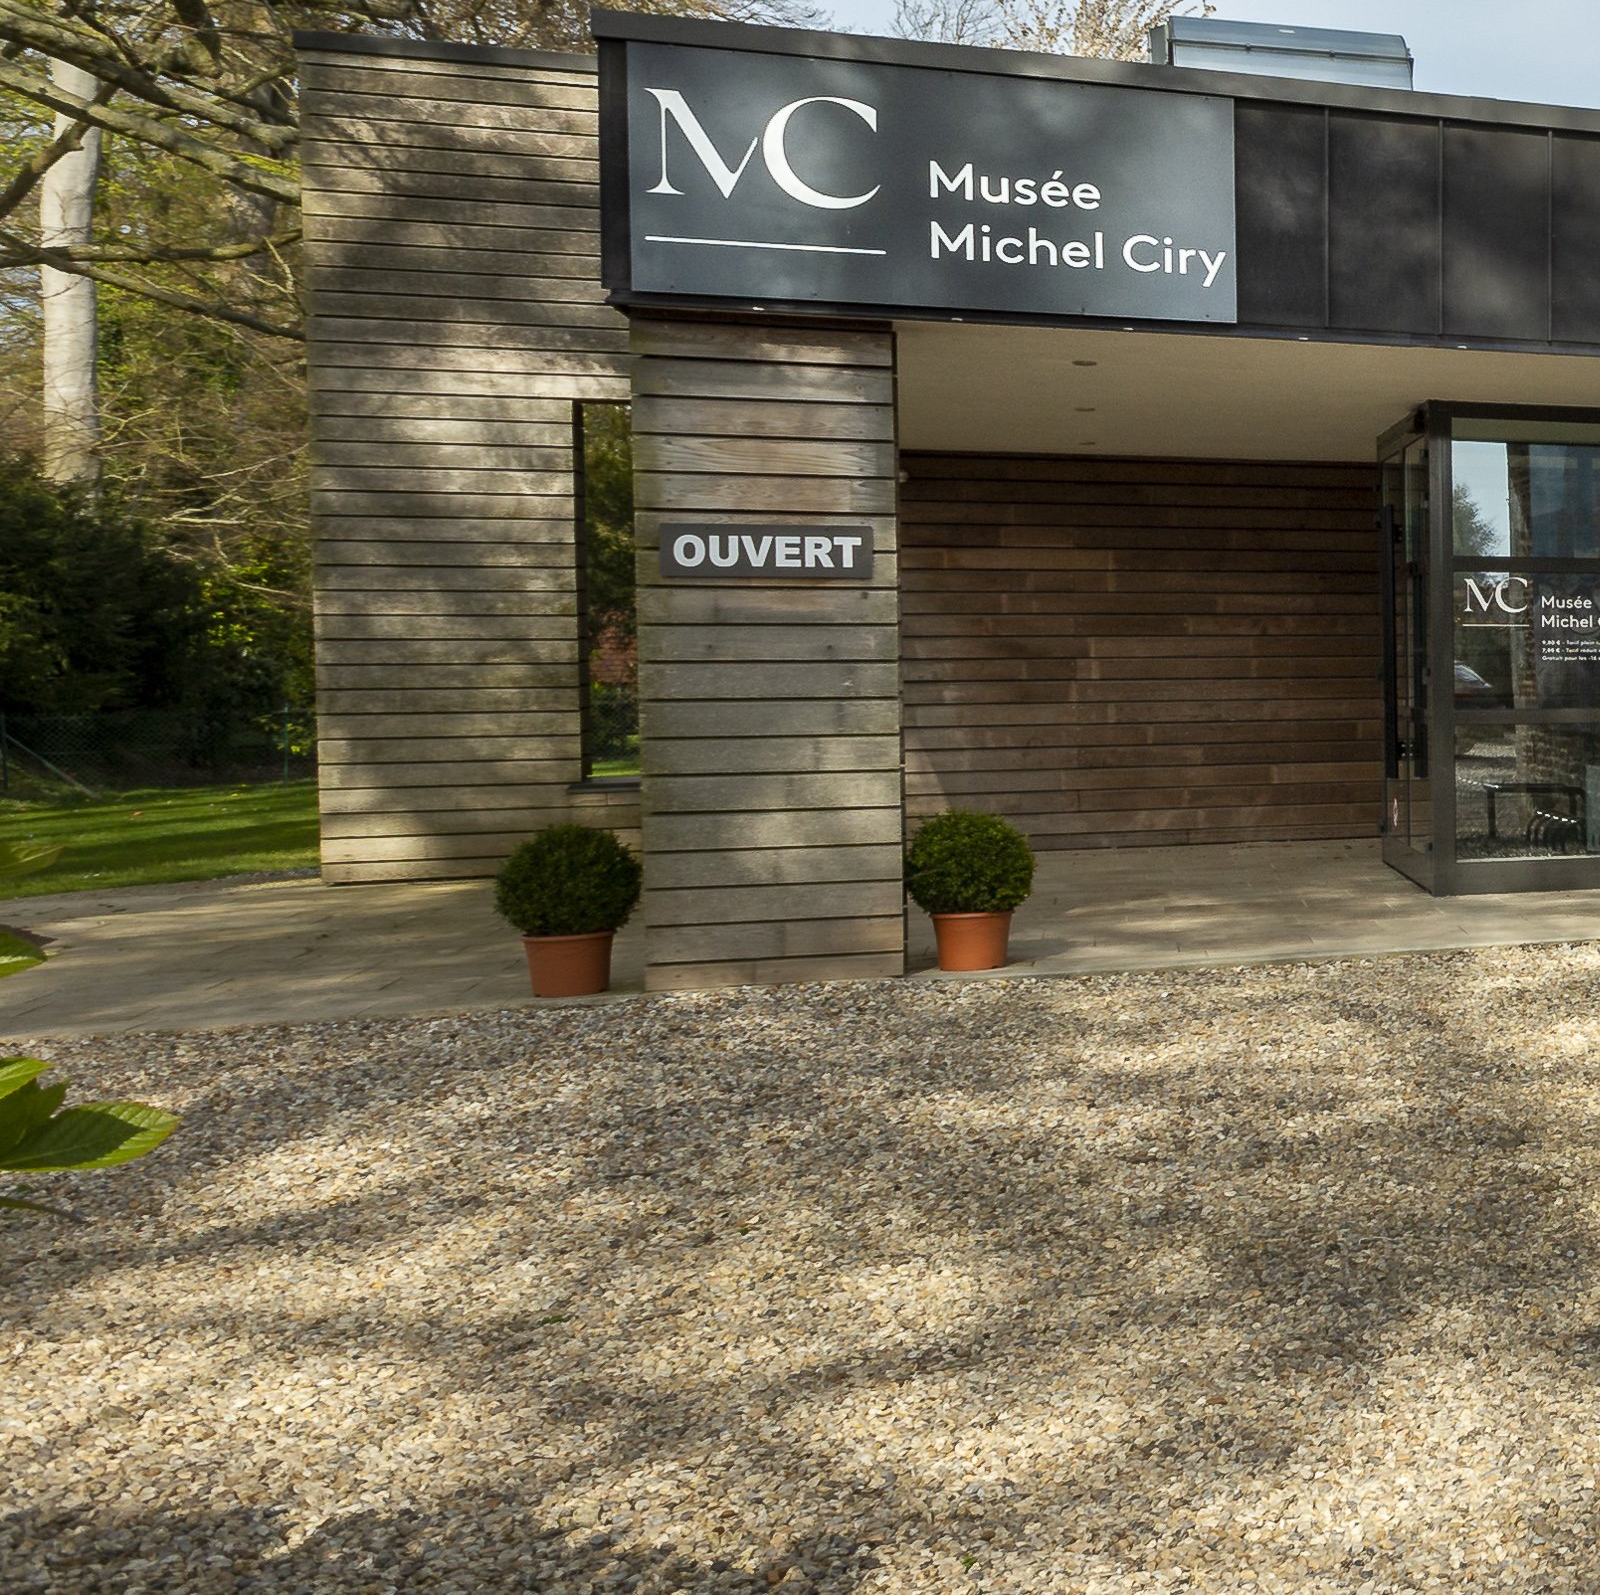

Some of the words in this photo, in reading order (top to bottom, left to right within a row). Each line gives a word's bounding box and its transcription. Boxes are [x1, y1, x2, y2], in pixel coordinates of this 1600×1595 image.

[644, 87, 881, 209] MC
[929, 160, 1101, 210] Musée
[930, 220, 1104, 269] Michel
[1122, 234, 1227, 288] Ciry
[673, 534, 862, 568] OUVERT
[1463, 576, 1528, 614] MC
[1541, 595, 1593, 609] Musée
[1541, 614, 1593, 628] Michel
